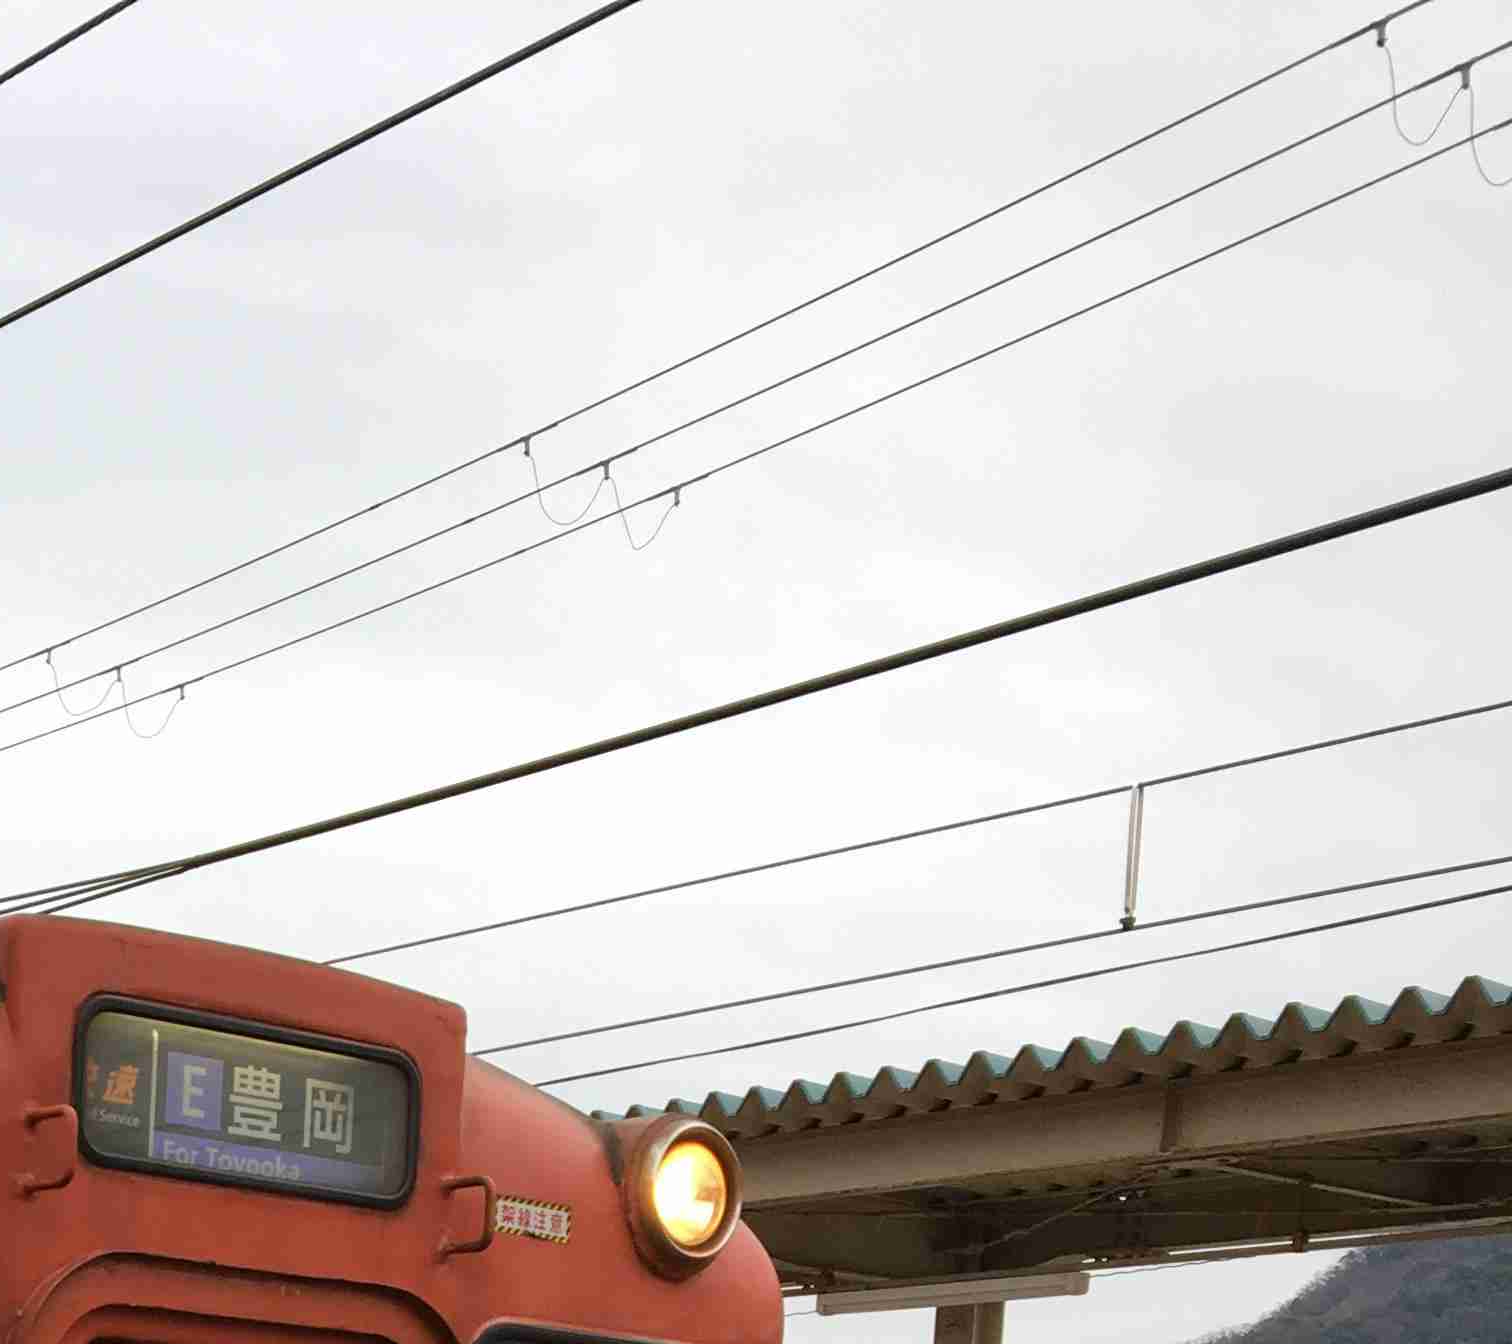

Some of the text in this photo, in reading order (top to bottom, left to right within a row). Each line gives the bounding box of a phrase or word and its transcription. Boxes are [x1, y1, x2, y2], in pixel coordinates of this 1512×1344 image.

[182, 1062, 207, 1122] E
[228, 1064, 355, 1155] 豊岡
[163, 1139, 198, 1166] For
